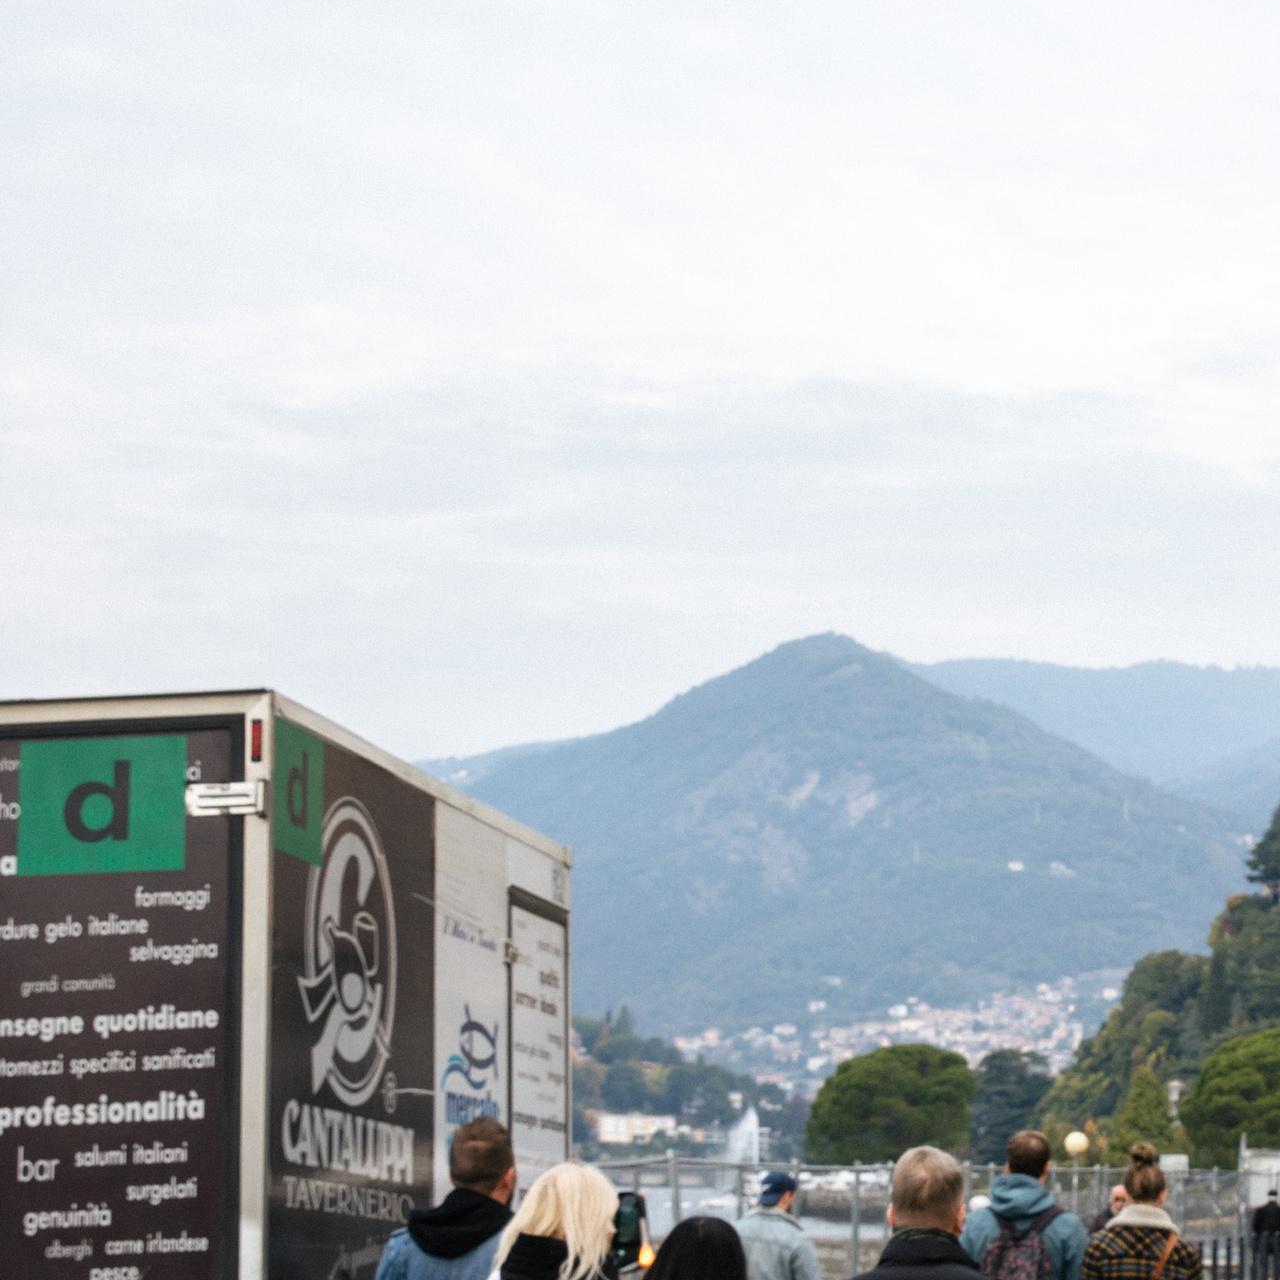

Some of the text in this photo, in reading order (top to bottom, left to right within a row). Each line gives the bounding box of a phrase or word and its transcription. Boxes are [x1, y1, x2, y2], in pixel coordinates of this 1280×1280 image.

[63, 760, 131, 843] d
[287, 751, 309, 830] d
[135, 884, 211, 910] formaggi
[45, 915, 83, 943] gelo
[88, 912, 149, 935] italiane
[129, 938, 219, 965] selvaggina
[21, 974, 59, 998] grandi
[93, 1004, 219, 1039] quotidiane
[69, 1050, 136, 1079] specifici
[142, 1047, 215, 1070] sanificati
[0, 1090, 205, 1136] professionalità
[17, 1145, 60, 1182] bar
[74, 1141, 188, 1167] salumi italiani
[126, 1176, 197, 1205] surgelati
[23, 1202, 112, 1236] genuinità
[105, 1230, 209, 1255] carne irlandese
